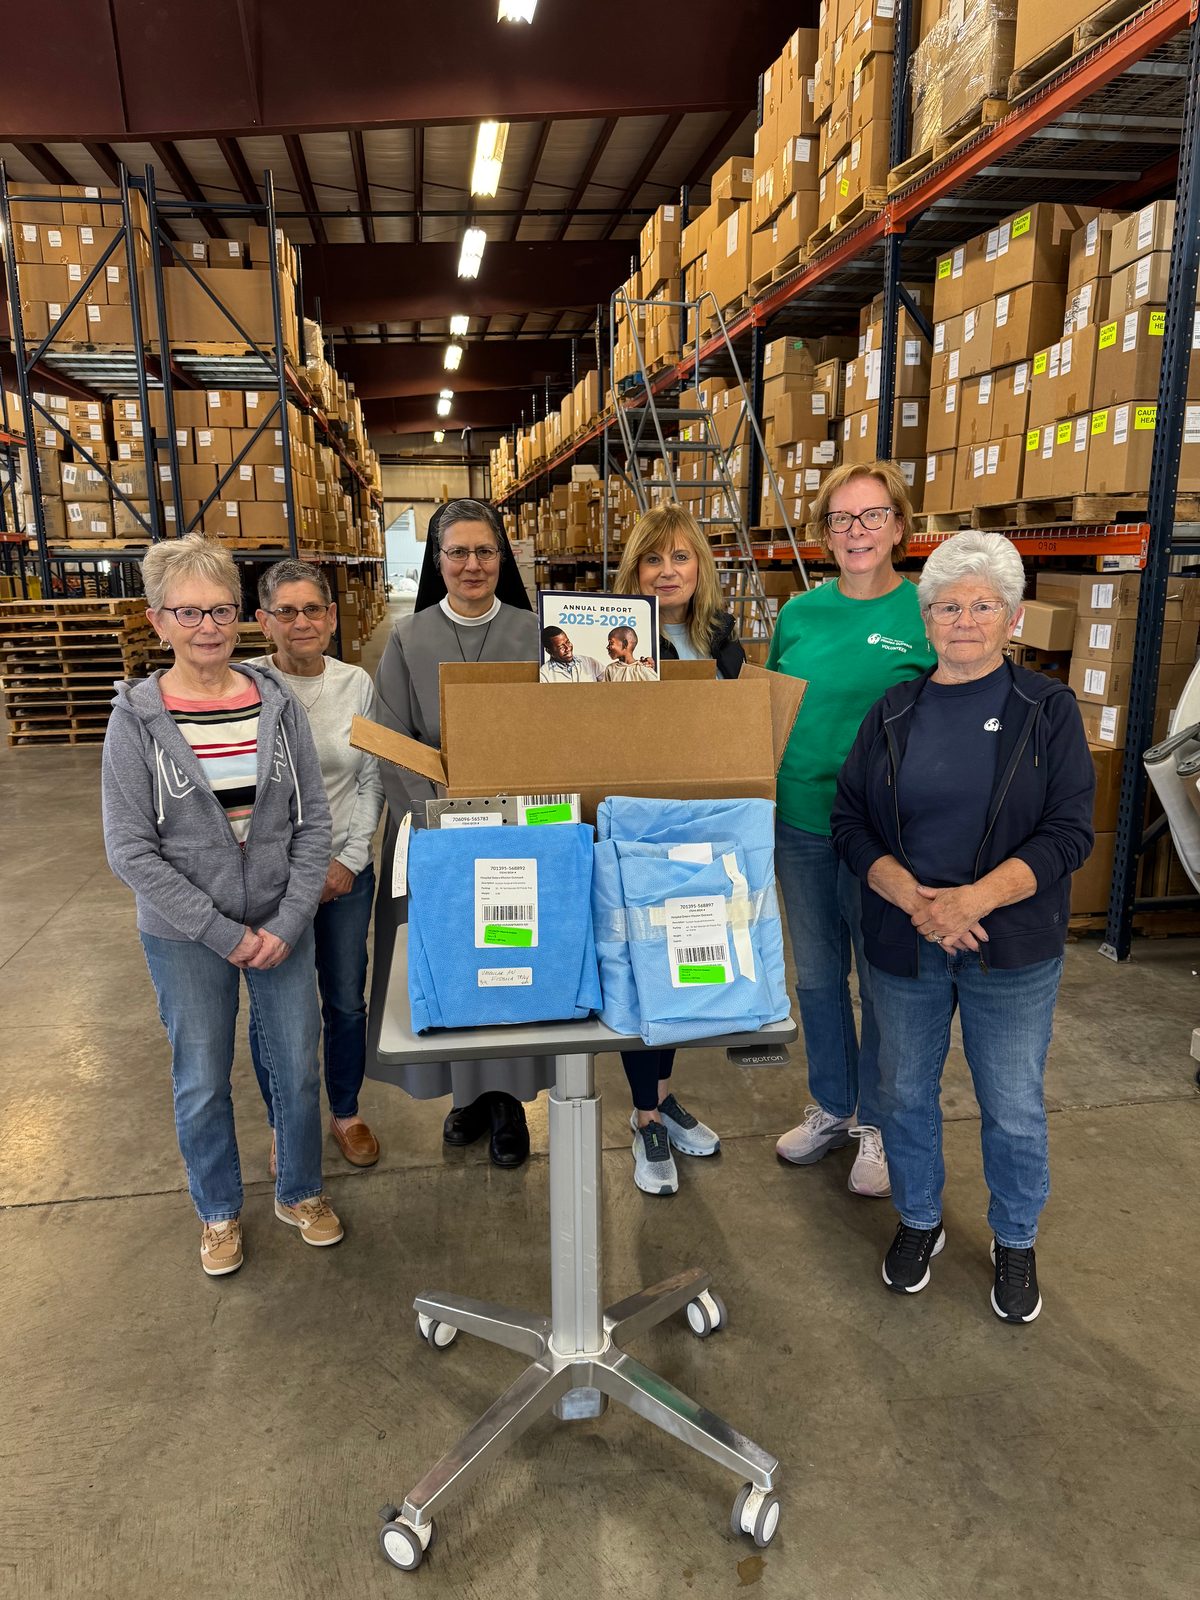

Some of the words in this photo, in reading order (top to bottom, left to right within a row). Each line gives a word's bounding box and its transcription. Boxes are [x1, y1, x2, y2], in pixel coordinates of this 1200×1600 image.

[1014, 216, 1028, 225] CAUTION
[1015, 223, 1025, 231] HEAVY
[1101, 326, 1115, 336] CAUTION
[563, 604, 597, 612] ANNUAL
[558, 613, 637, 627] 2025-2026
[882, 644, 906, 653] VOLUNTEER
[741, 1055, 784, 1064] ergotron
